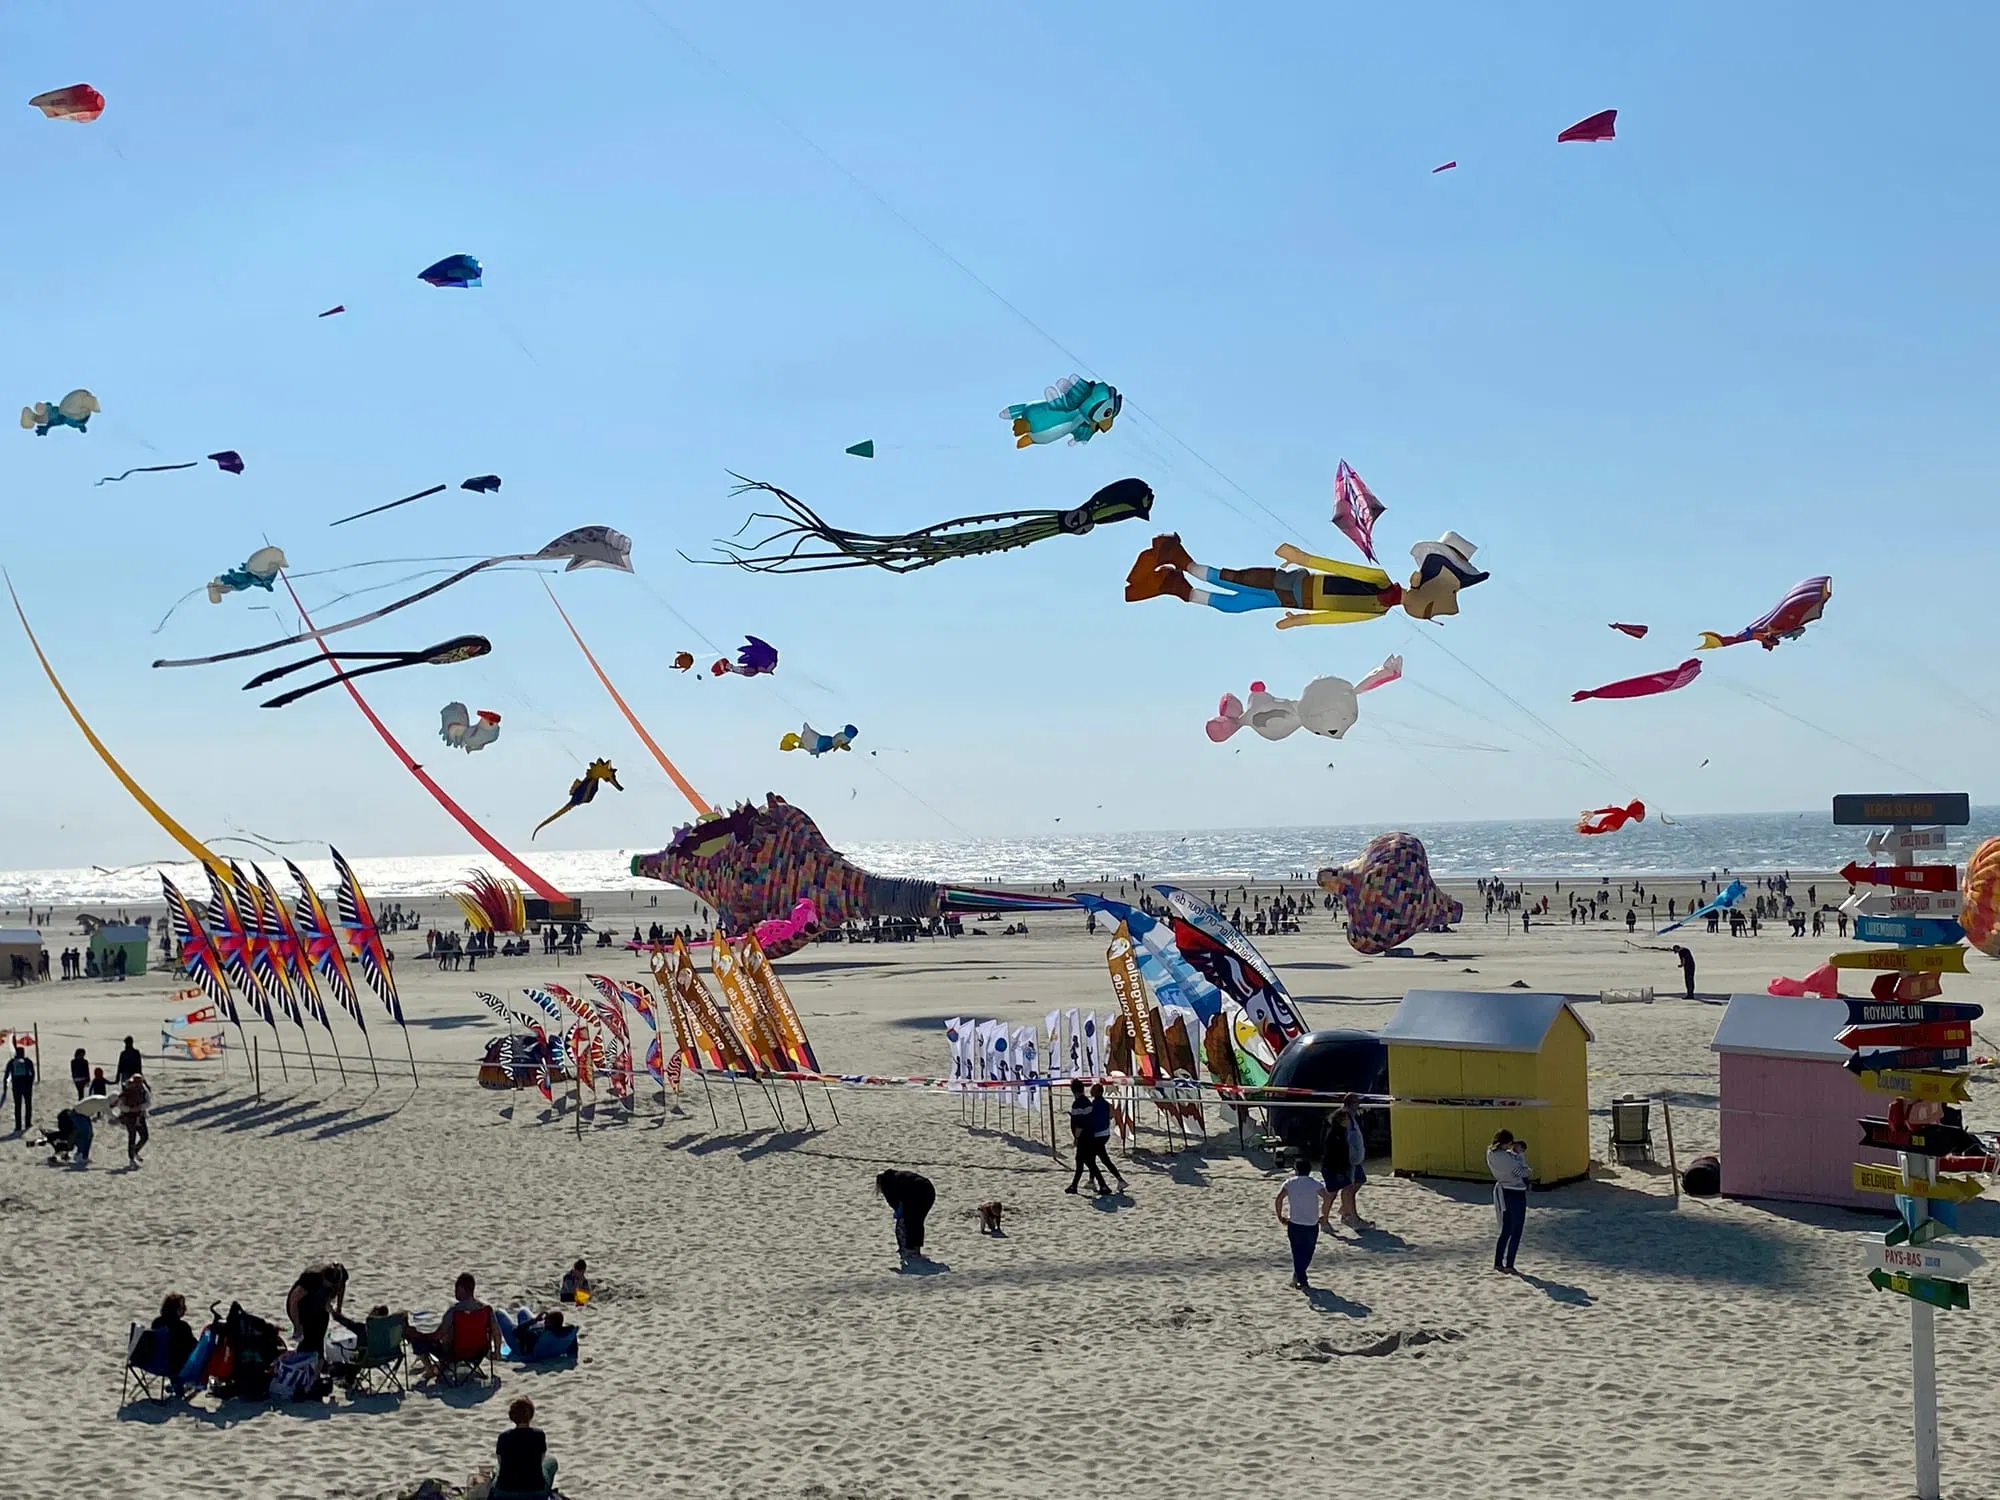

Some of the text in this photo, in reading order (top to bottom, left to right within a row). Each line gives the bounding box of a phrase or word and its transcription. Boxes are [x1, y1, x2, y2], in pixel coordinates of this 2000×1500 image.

[1890, 896, 1930, 911] SINGAPOUR
[1868, 953, 1908, 968] ESPAGNE
[1863, 1006, 1906, 1021] ROYAUME
[1908, 1005, 1924, 1020] UNI
[1861, 1172, 1897, 1190] BELGIQUE
[1884, 1249, 1922, 1267] PAYS-BAS
